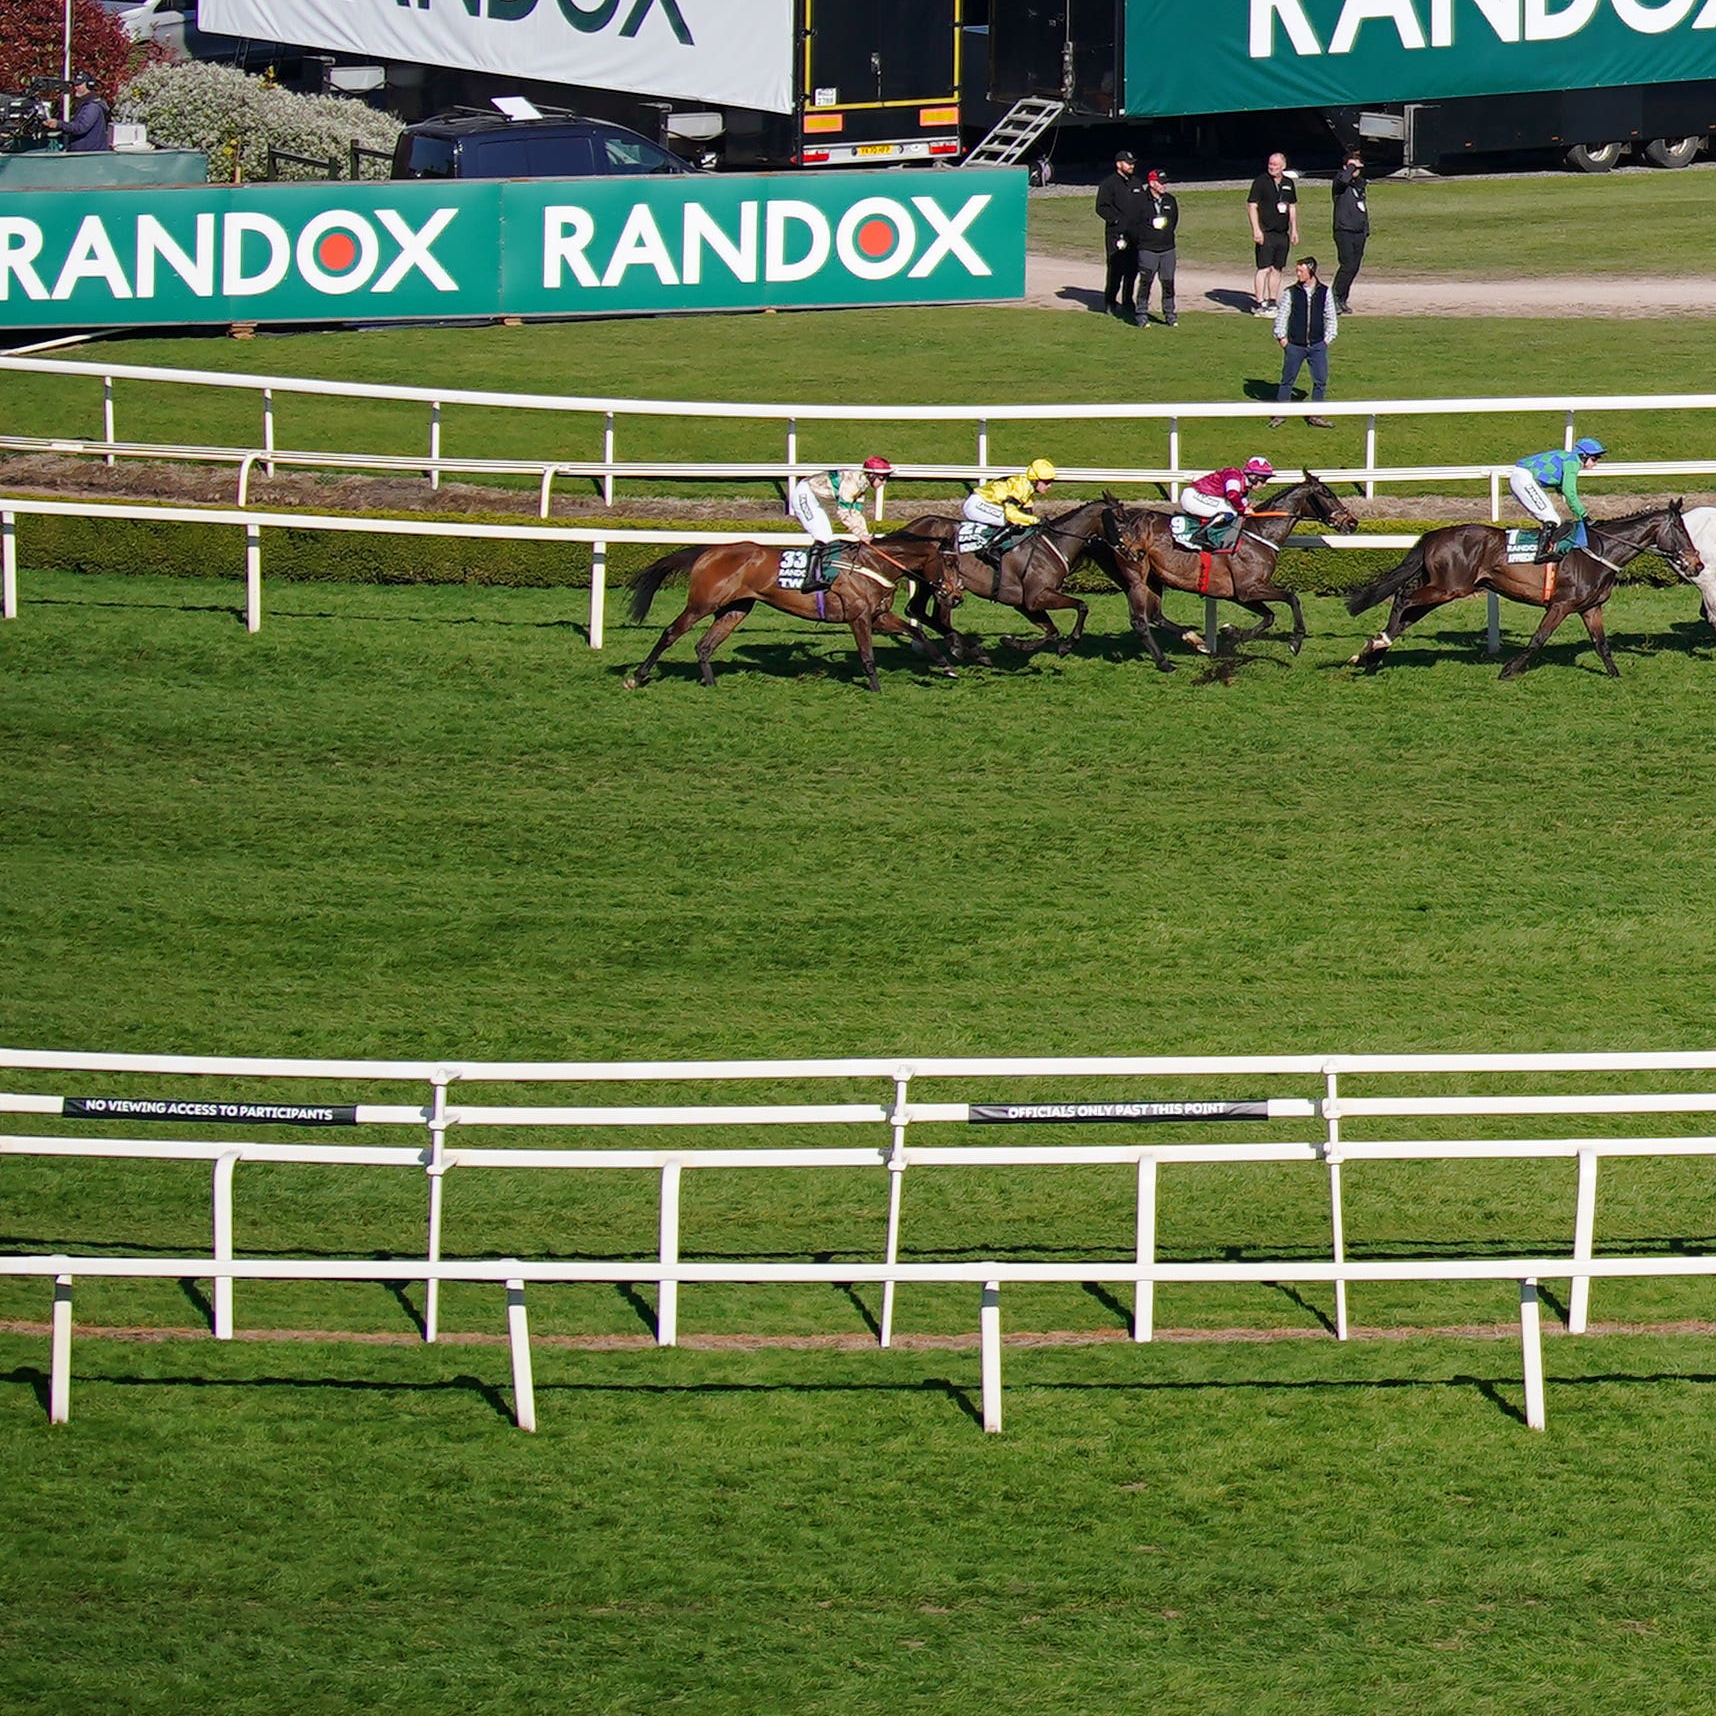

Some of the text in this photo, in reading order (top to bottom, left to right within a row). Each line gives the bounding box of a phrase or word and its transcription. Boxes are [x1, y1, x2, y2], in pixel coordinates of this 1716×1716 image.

[0, 195, 992, 301] RANDOX RANDOX
[1171, 516, 1186, 533] 9
[1507, 544, 1538, 553] RANDO
[781, 550, 807, 569] 33
[86, 1099, 333, 1120] NO VIEWING ACCESS TO PARTICIPANTS
[1007, 1102, 1226, 1119] OFFICIALS ONLY PAST THIS POINT
